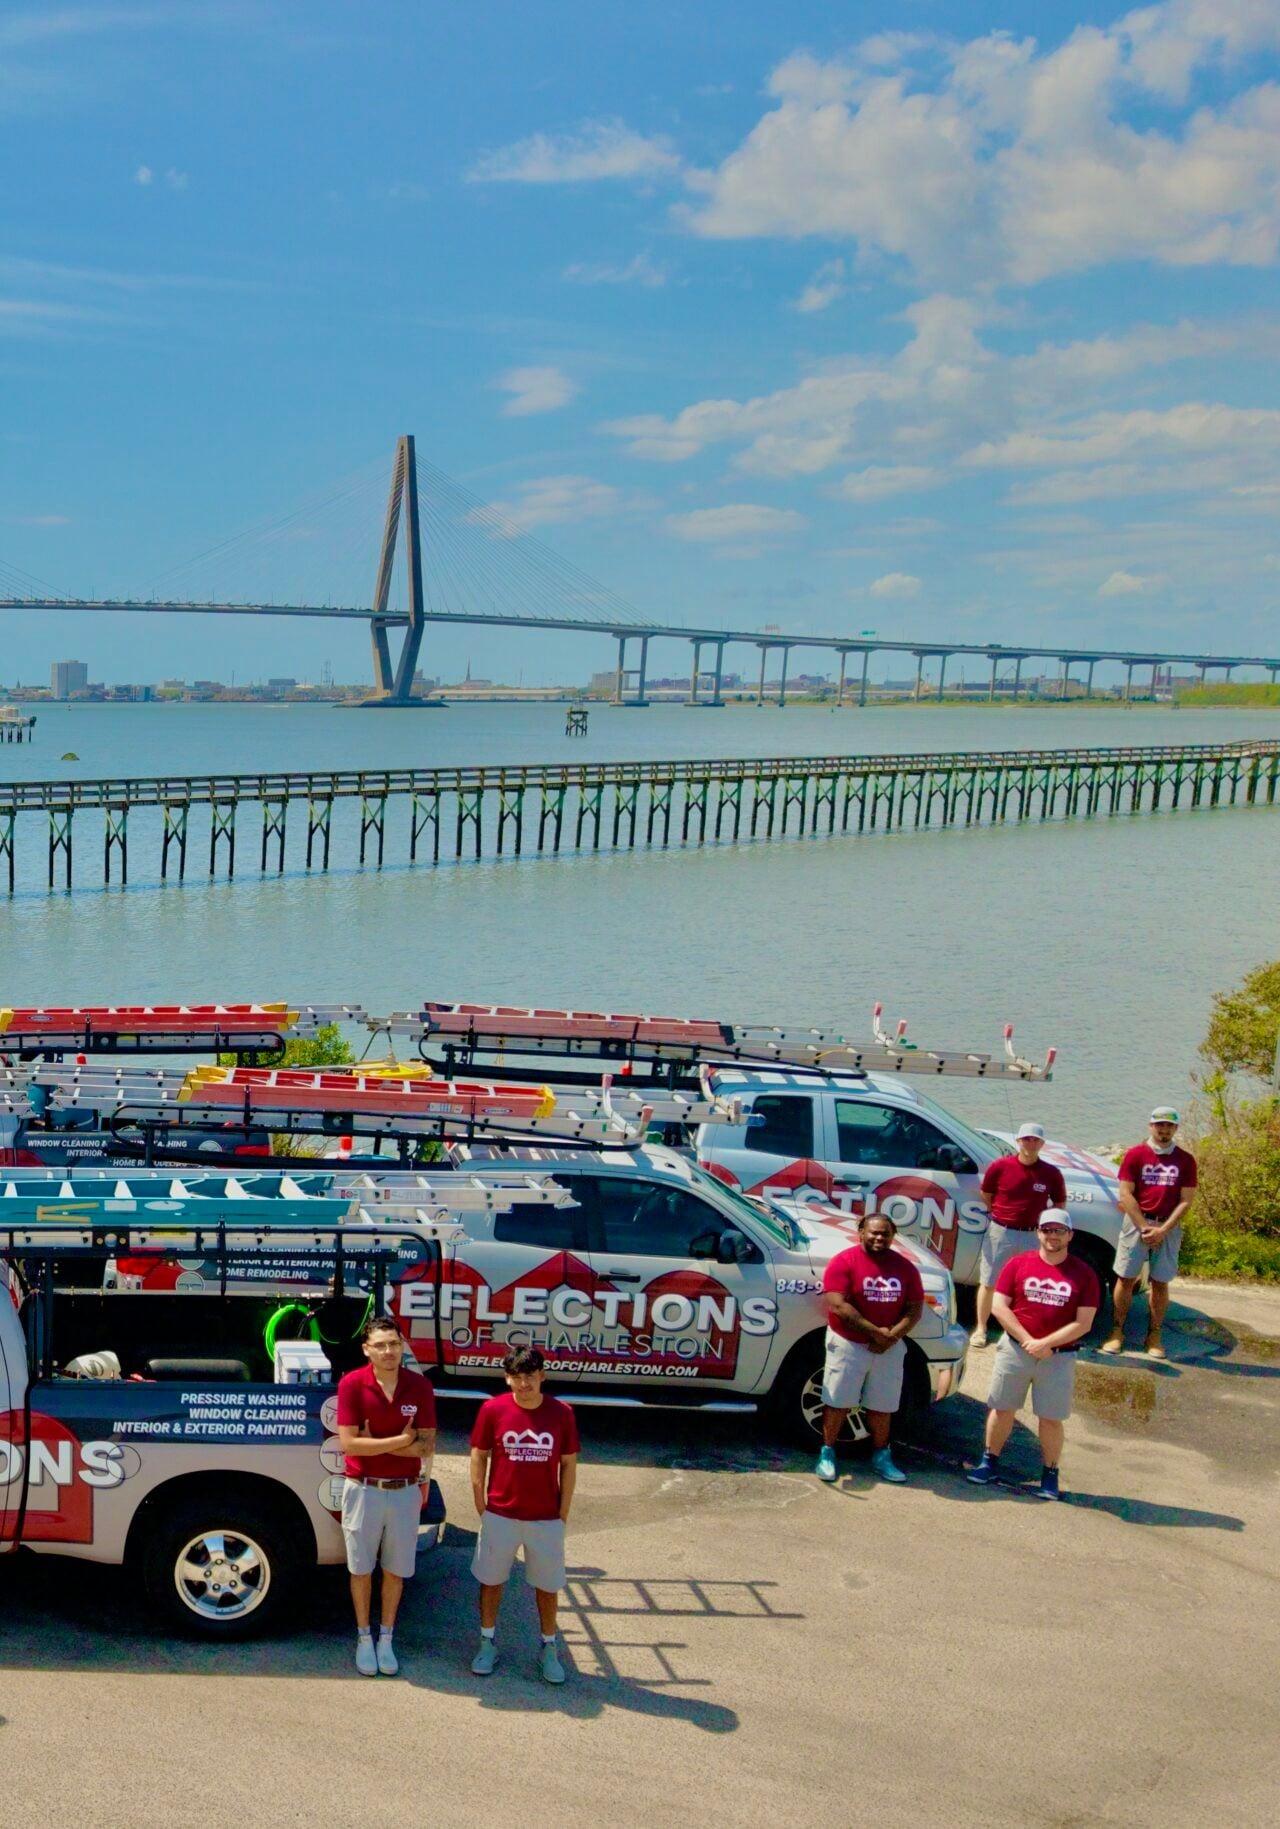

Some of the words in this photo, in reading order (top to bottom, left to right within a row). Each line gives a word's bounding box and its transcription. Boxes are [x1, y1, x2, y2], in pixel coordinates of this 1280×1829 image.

[27, 1140, 61, 1148] WINDOW
[62, 1140, 100, 1148] CLEANING
[66, 1149, 103, 1157] INTERIOR
[246, 1267, 309, 1280] REMODELING
[450, 1325, 494, 1348] OF
[504, 1327, 724, 1360] CHARLESTON
[458, 1355, 699, 1377] REFLECSOFCHARLESTON.COM
[180, 1393, 246, 1406] PRESSURE
[247, 1394, 307, 1406] WASHING
[189, 1407, 241, 1420] WINDOW
[243, 1408, 307, 1421] CLEANING
[112, 1421, 170, 1434] INTERIOR
[172, 1422, 182, 1434] &
[184, 1422, 245, 1435] EXTERIOR
[246, 1423, 307, 1436] PAINTING
[504, 1447, 553, 1457] REFLECTIONS
